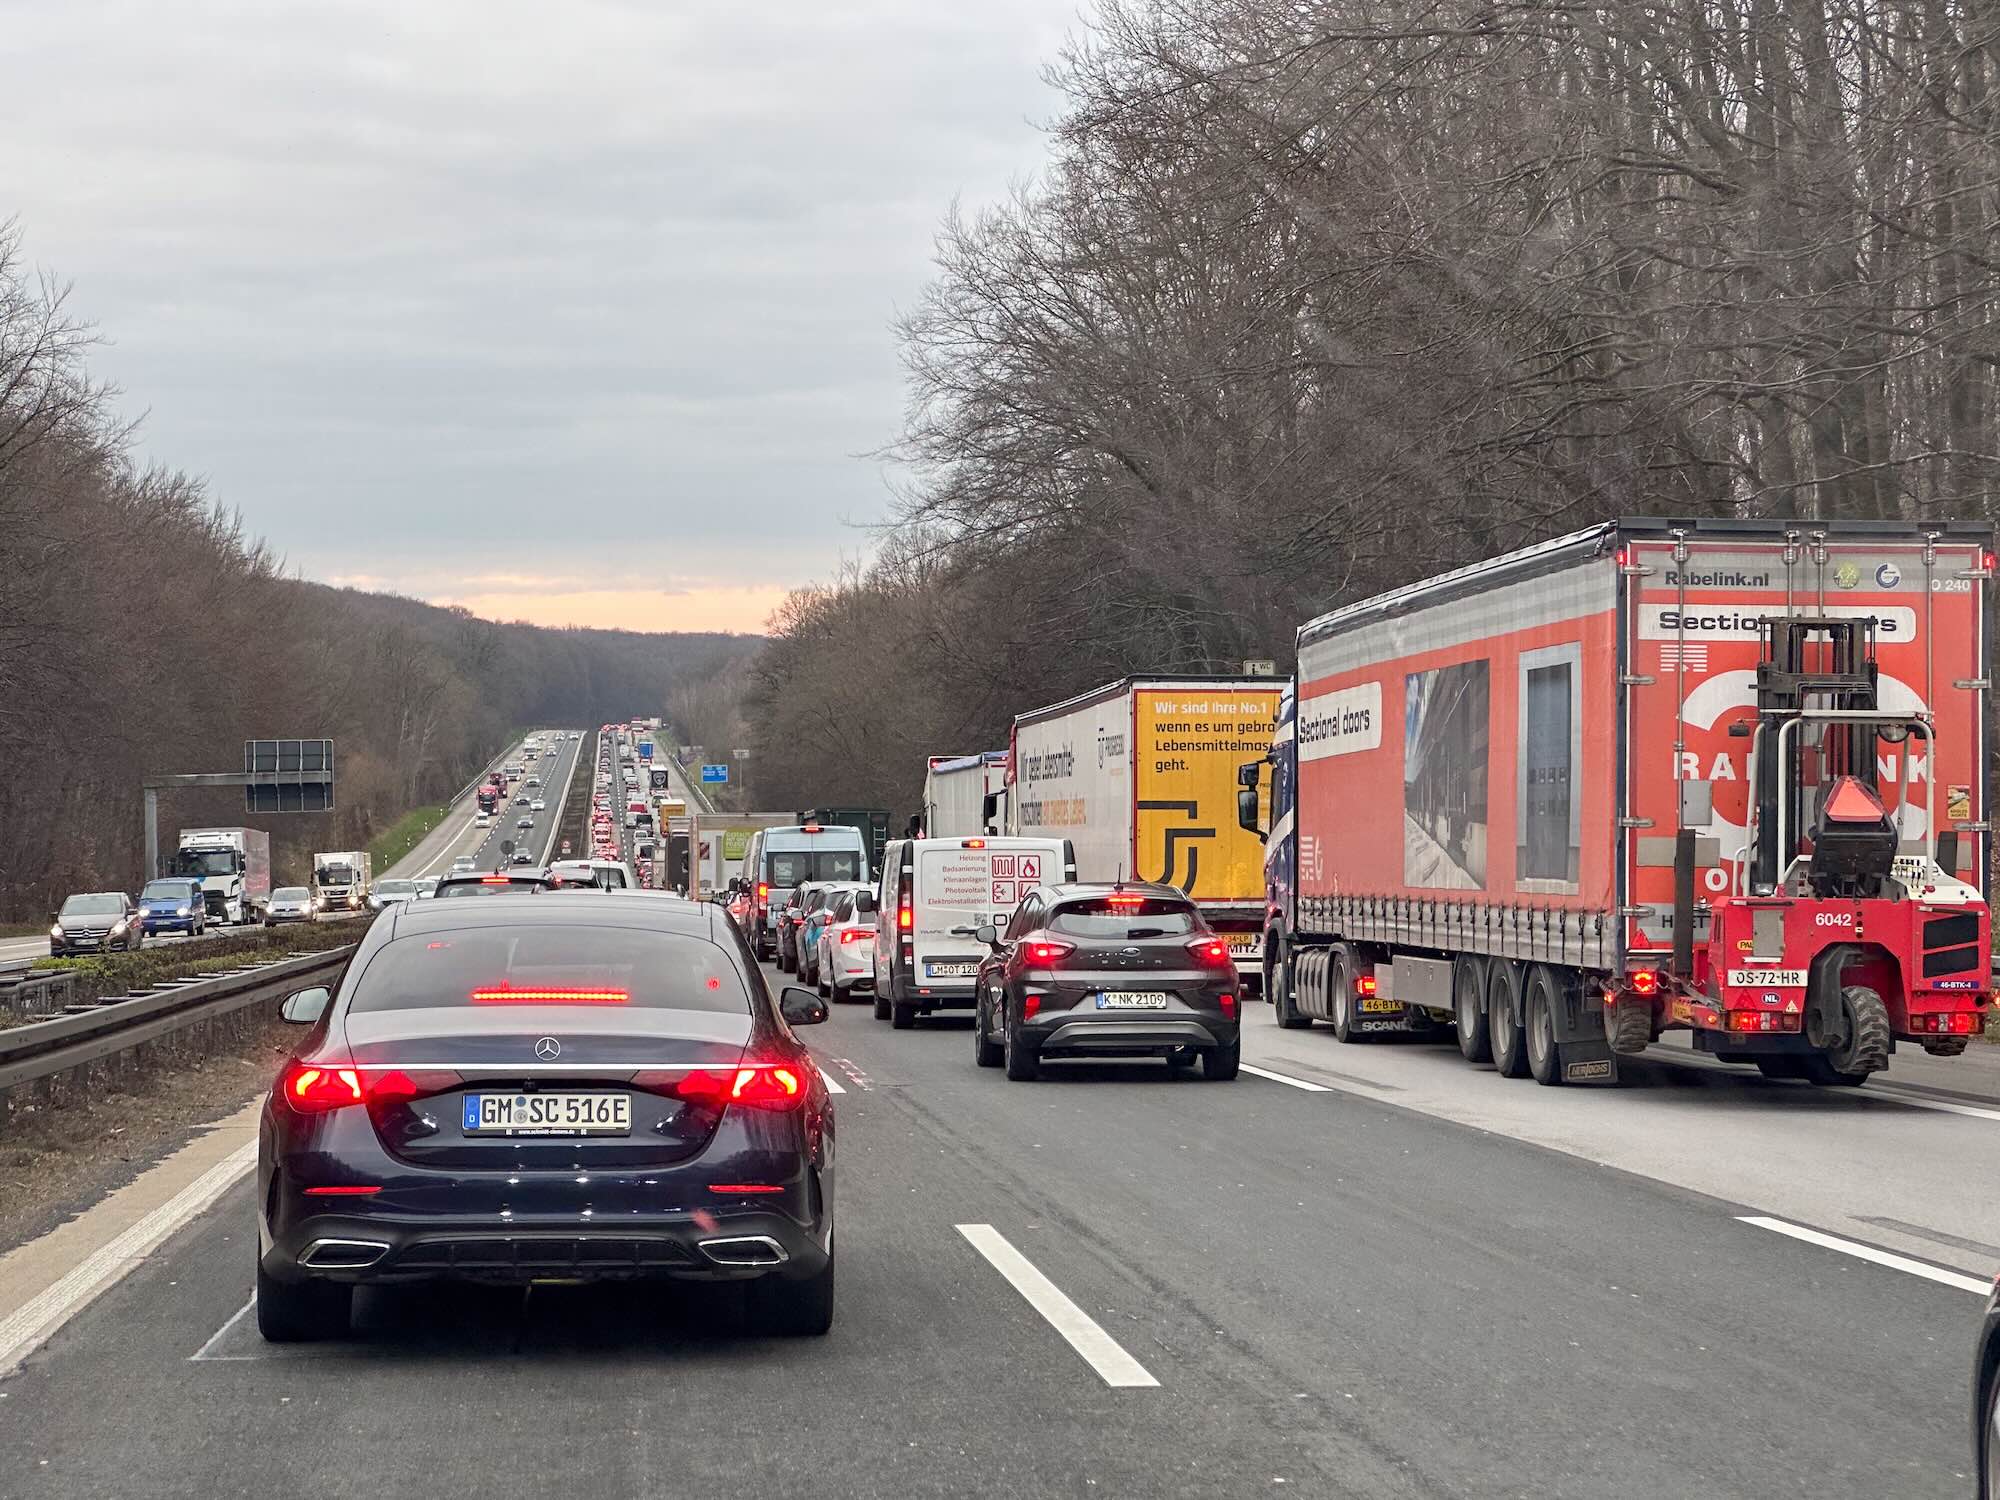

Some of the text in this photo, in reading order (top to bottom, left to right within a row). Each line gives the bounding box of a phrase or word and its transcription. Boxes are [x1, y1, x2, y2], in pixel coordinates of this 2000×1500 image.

[1665, 571, 1769, 587] Rabelink.nl
[1945, 580, 1970, 591] 240
[1155, 701, 1266, 714] Wir sind Ihre No.1
[1155, 722, 1190, 732] wenn
[1195, 722, 1208, 732] es
[1213, 722, 1233, 732] um
[1299, 705, 1370, 744] Sectional doors
[1155, 758, 1189, 772] geht.
[1816, 913, 1852, 926] 6042
[1737, 972, 1800, 984] OS-72-HR
[1104, 994, 1163, 1005] K NK 2109
[1765, 994, 1777, 1003] NL
[482, 1097, 627, 1123] GM SC 516E
